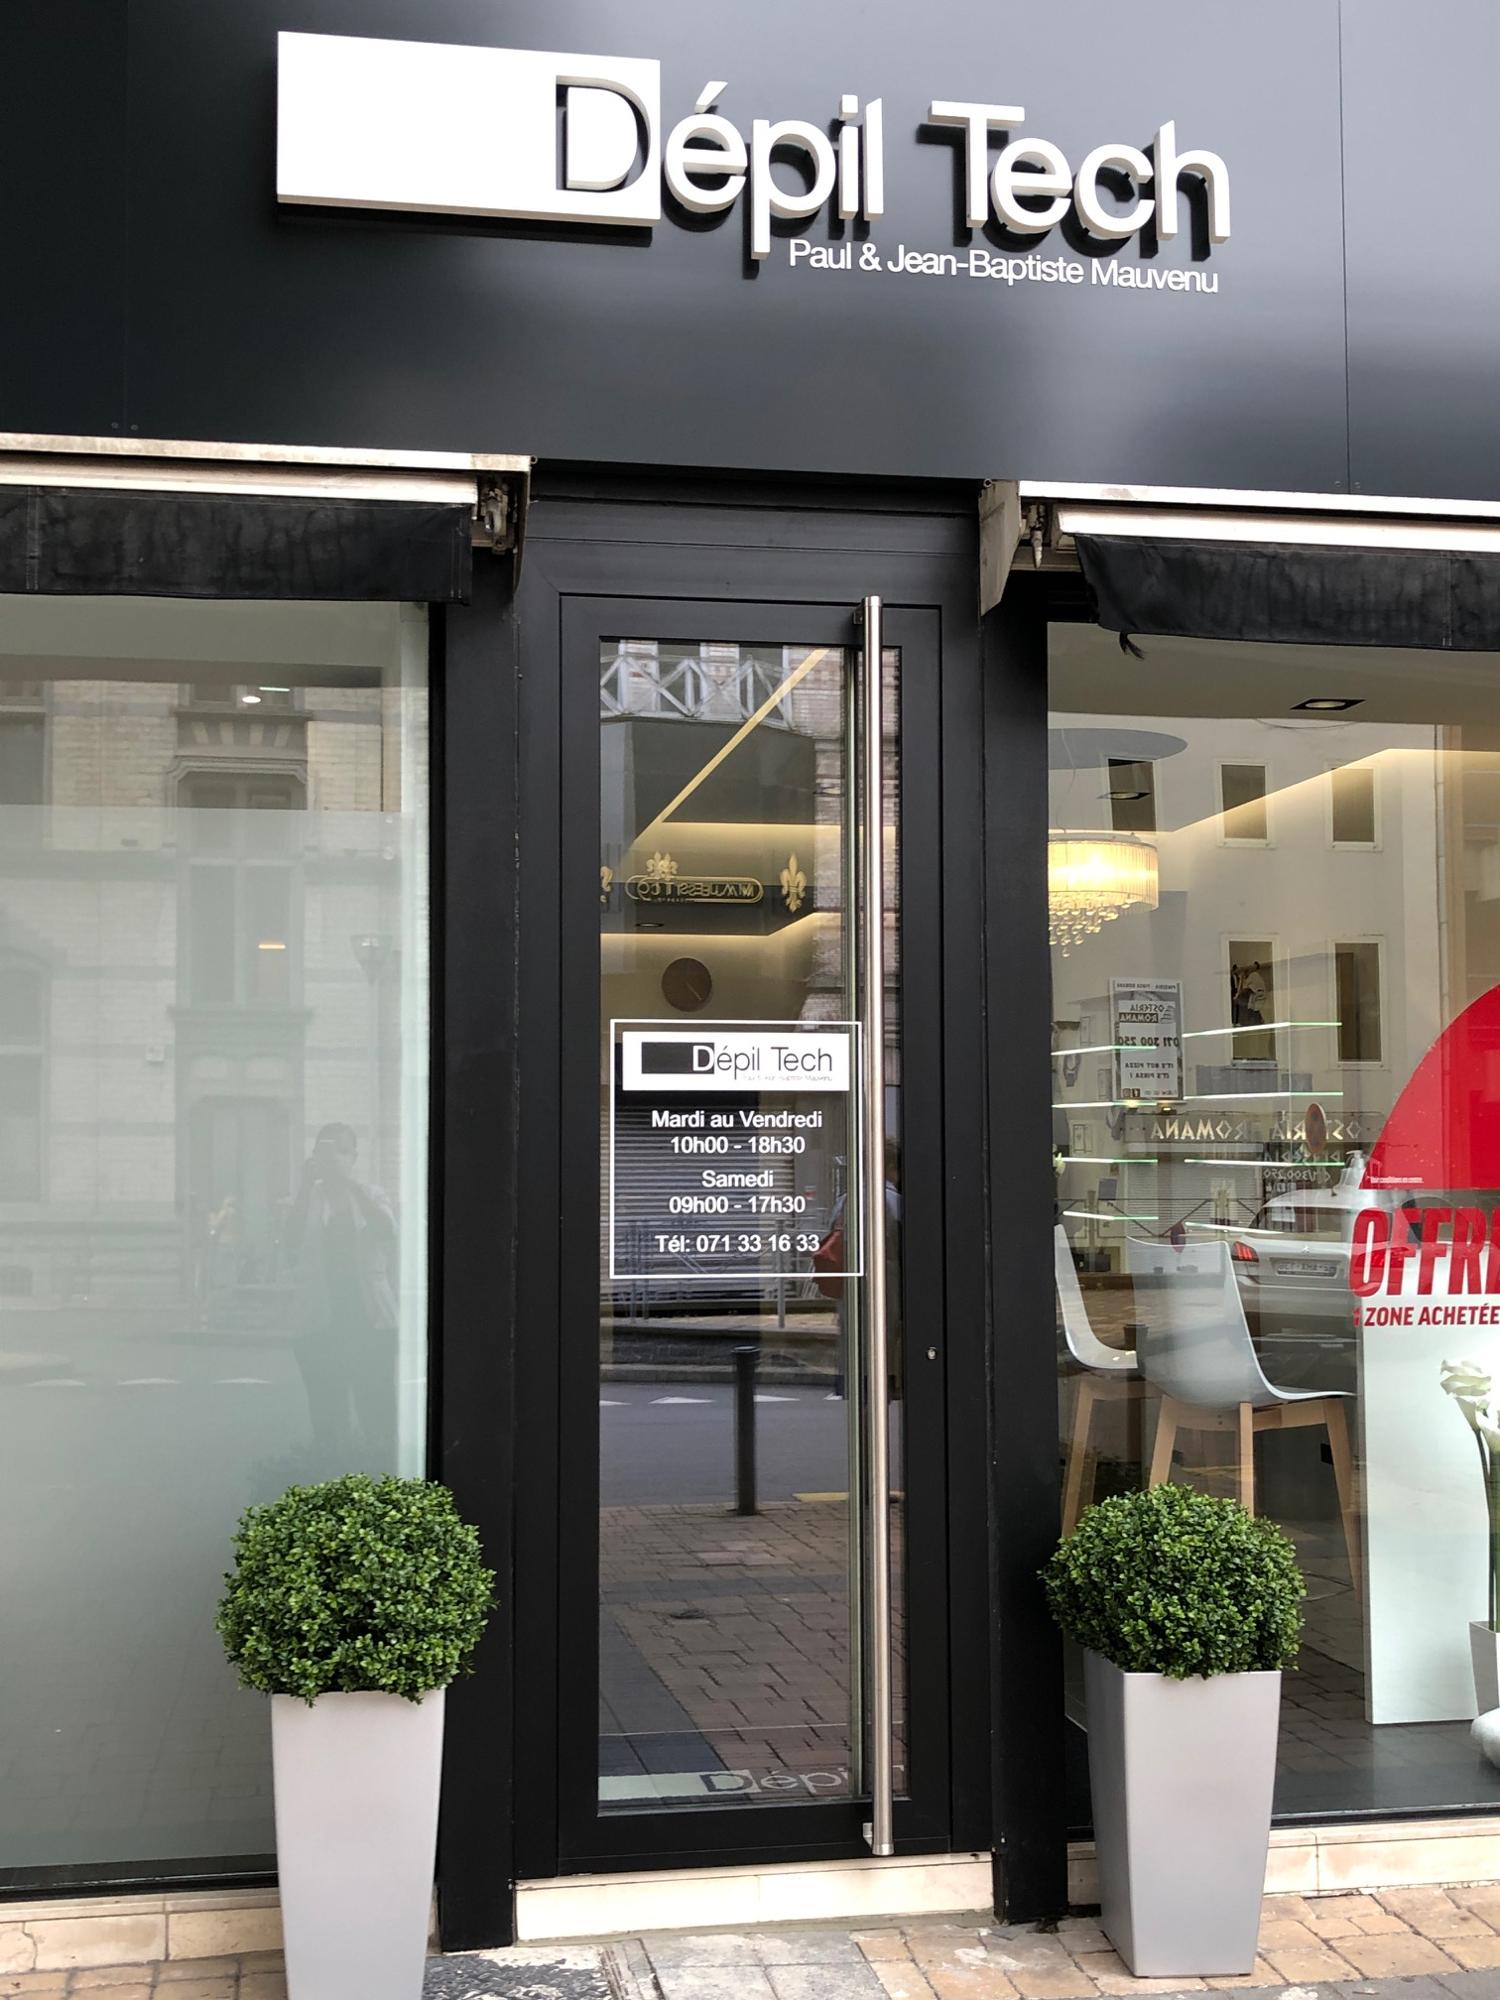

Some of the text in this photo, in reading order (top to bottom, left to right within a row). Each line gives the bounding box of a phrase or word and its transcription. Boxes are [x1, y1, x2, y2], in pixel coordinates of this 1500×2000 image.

[555, 75, 1231, 260] Dépil Tech
[789, 239, 1219, 293] Paul & Jean-Baptiste Mauvenu
[692, 1045, 833, 1080] Dépil Tech
[651, 1110, 823, 1128] Mardi au Vendredi
[670, 1136, 729, 1154] 10h00
[747, 1136, 806, 1154] 18h30
[701, 1170, 774, 1187] Samedi
[669, 1196, 729, 1213] 09h00
[747, 1196, 806, 1213] 17h30
[655, 1234, 820, 1252] Tél: 071 33 16 33
[1364, 1306, 1415, 1327] ZONE
[1418, 1303, 1500, 1326] ACHETÉE
